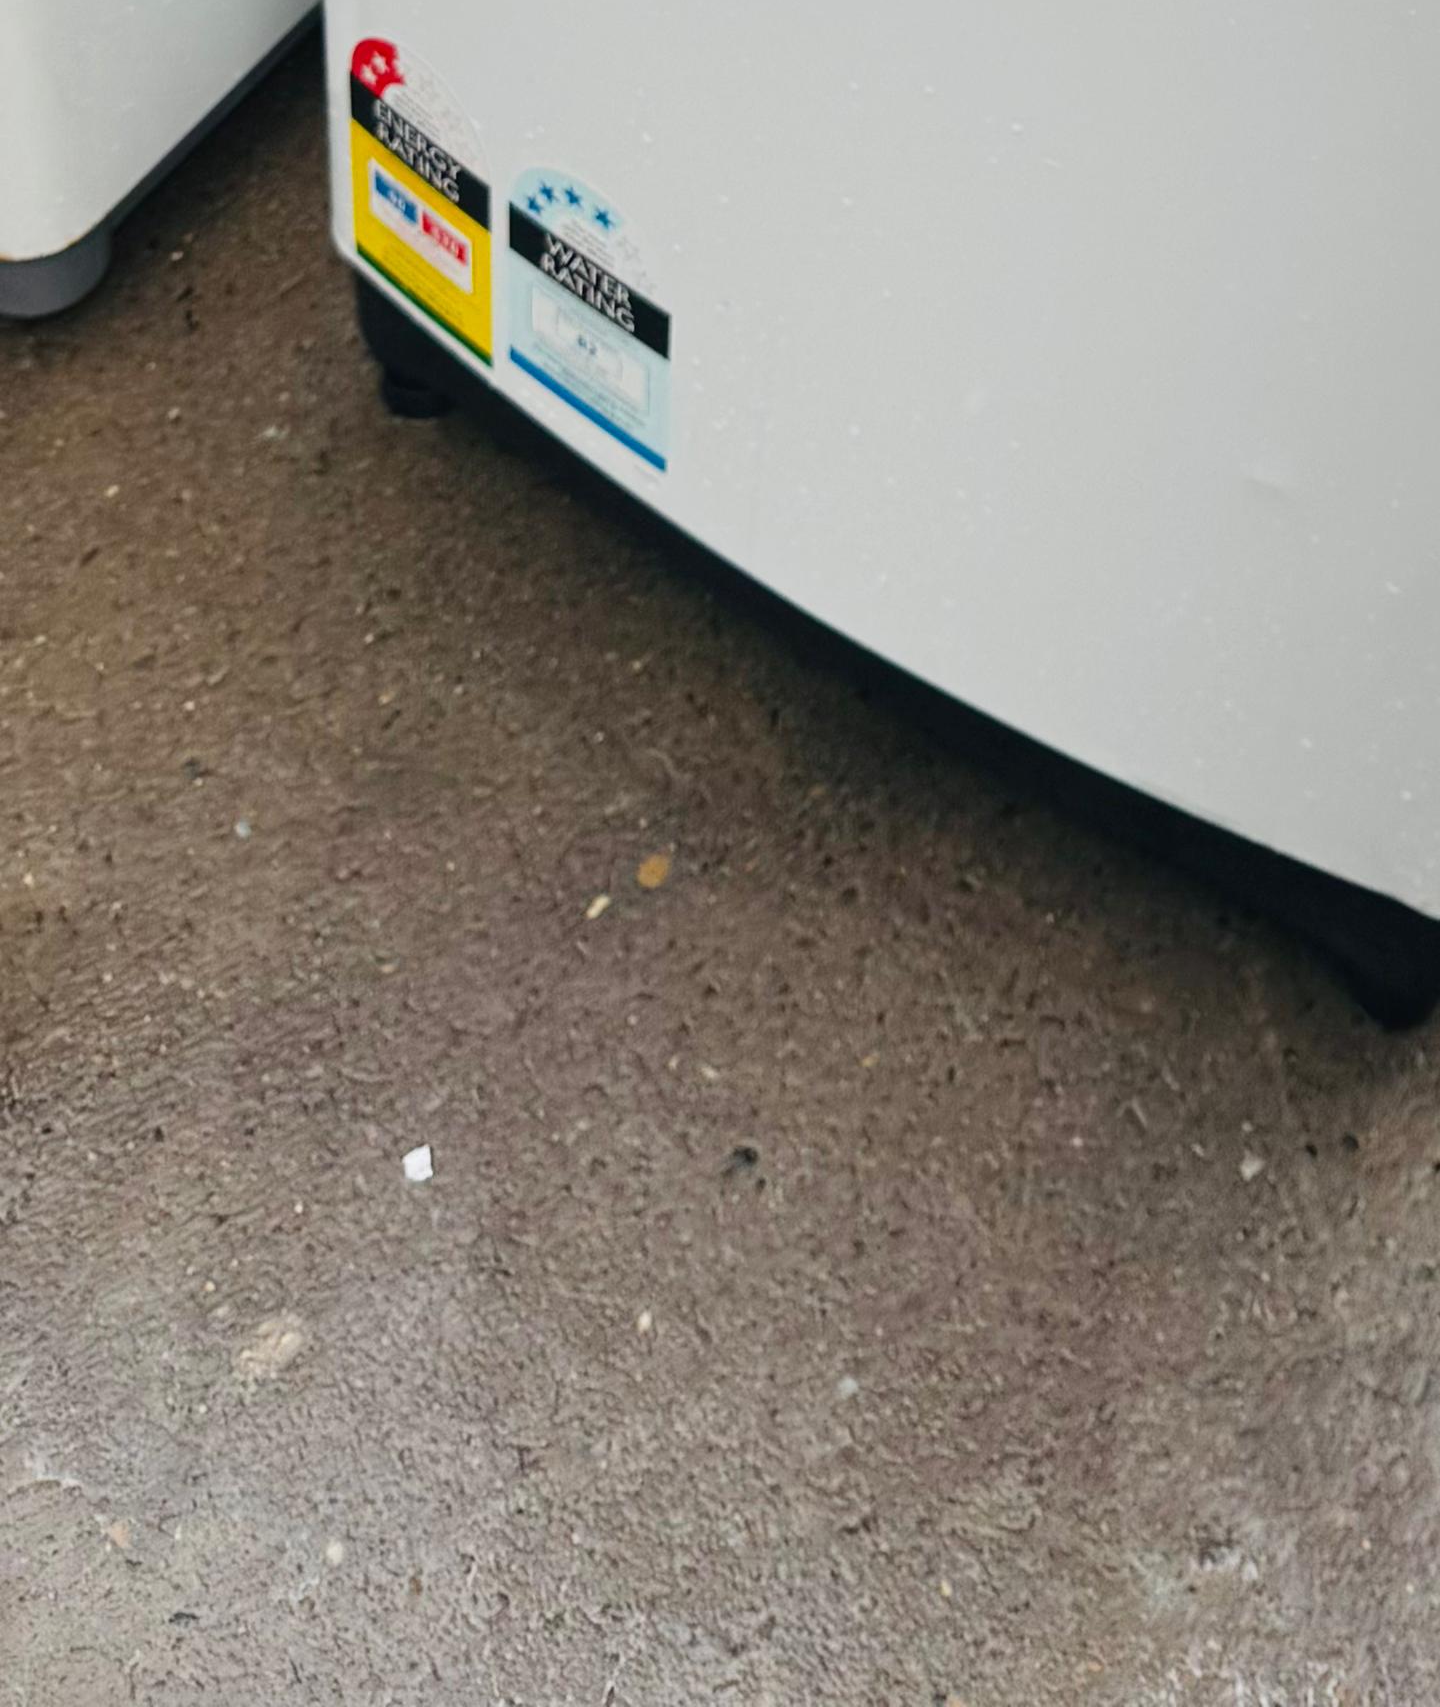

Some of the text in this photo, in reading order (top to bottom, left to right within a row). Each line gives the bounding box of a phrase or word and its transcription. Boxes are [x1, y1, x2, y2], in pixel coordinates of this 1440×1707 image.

[374, 98, 461, 180] ENERGY
[375, 121, 459, 203] RATING
[540, 253, 635, 333] RATING
[546, 232, 632, 310] WATER
